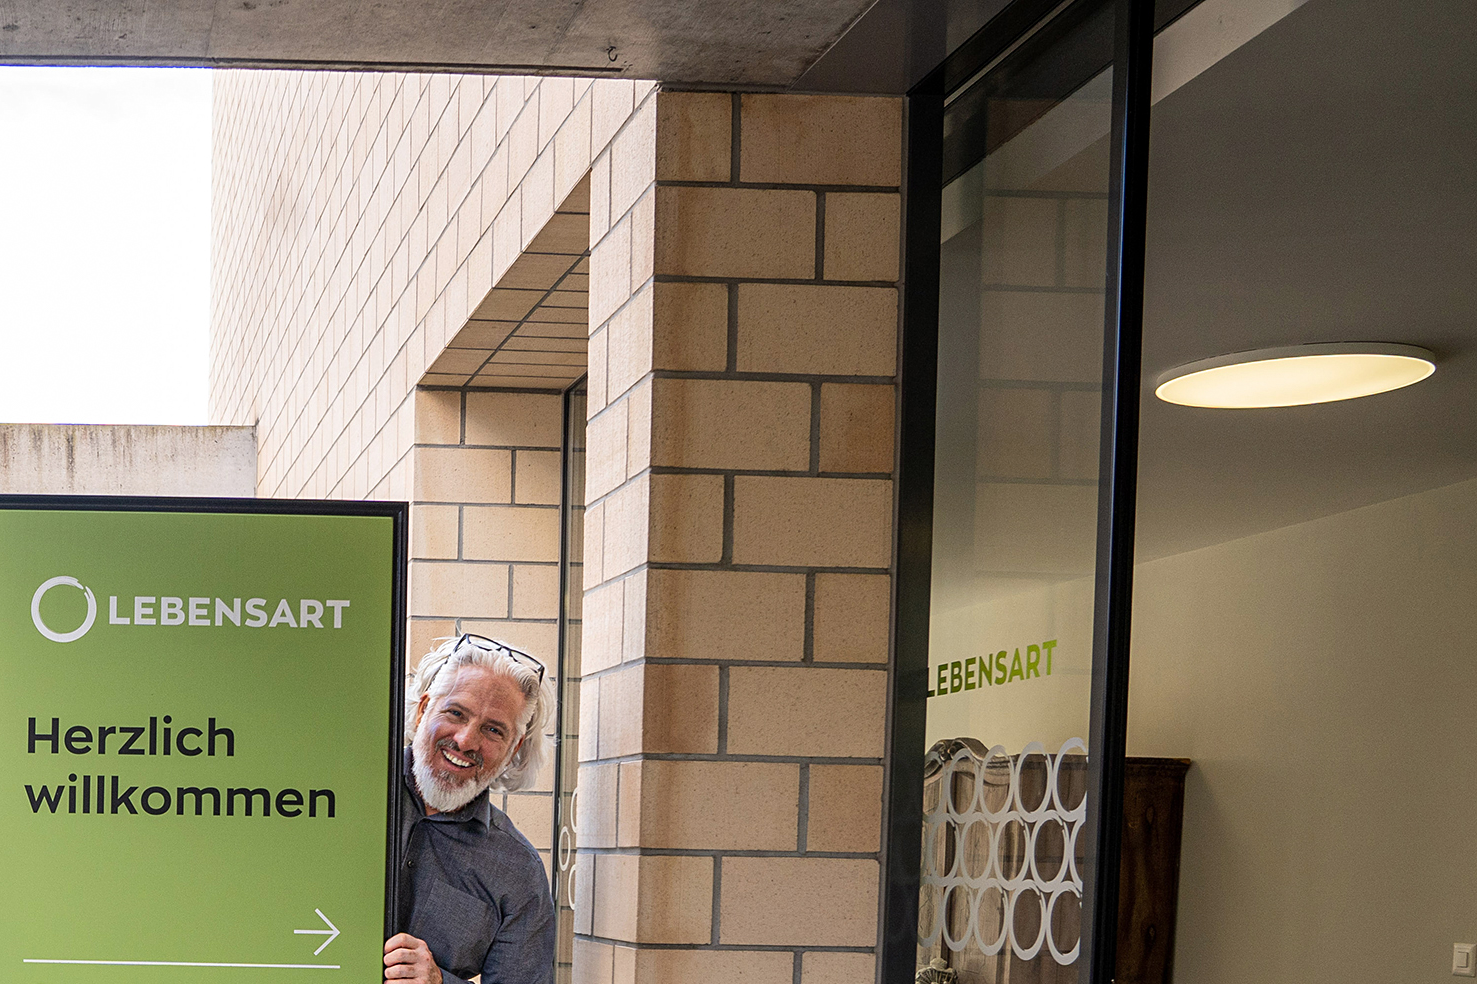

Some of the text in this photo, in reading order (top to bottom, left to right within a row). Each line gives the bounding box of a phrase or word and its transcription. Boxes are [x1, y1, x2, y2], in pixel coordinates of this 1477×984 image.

[108, 595, 351, 629] LEBENSART
[27, 714, 236, 757] Herzlich
[24, 773, 337, 818] willkommen
